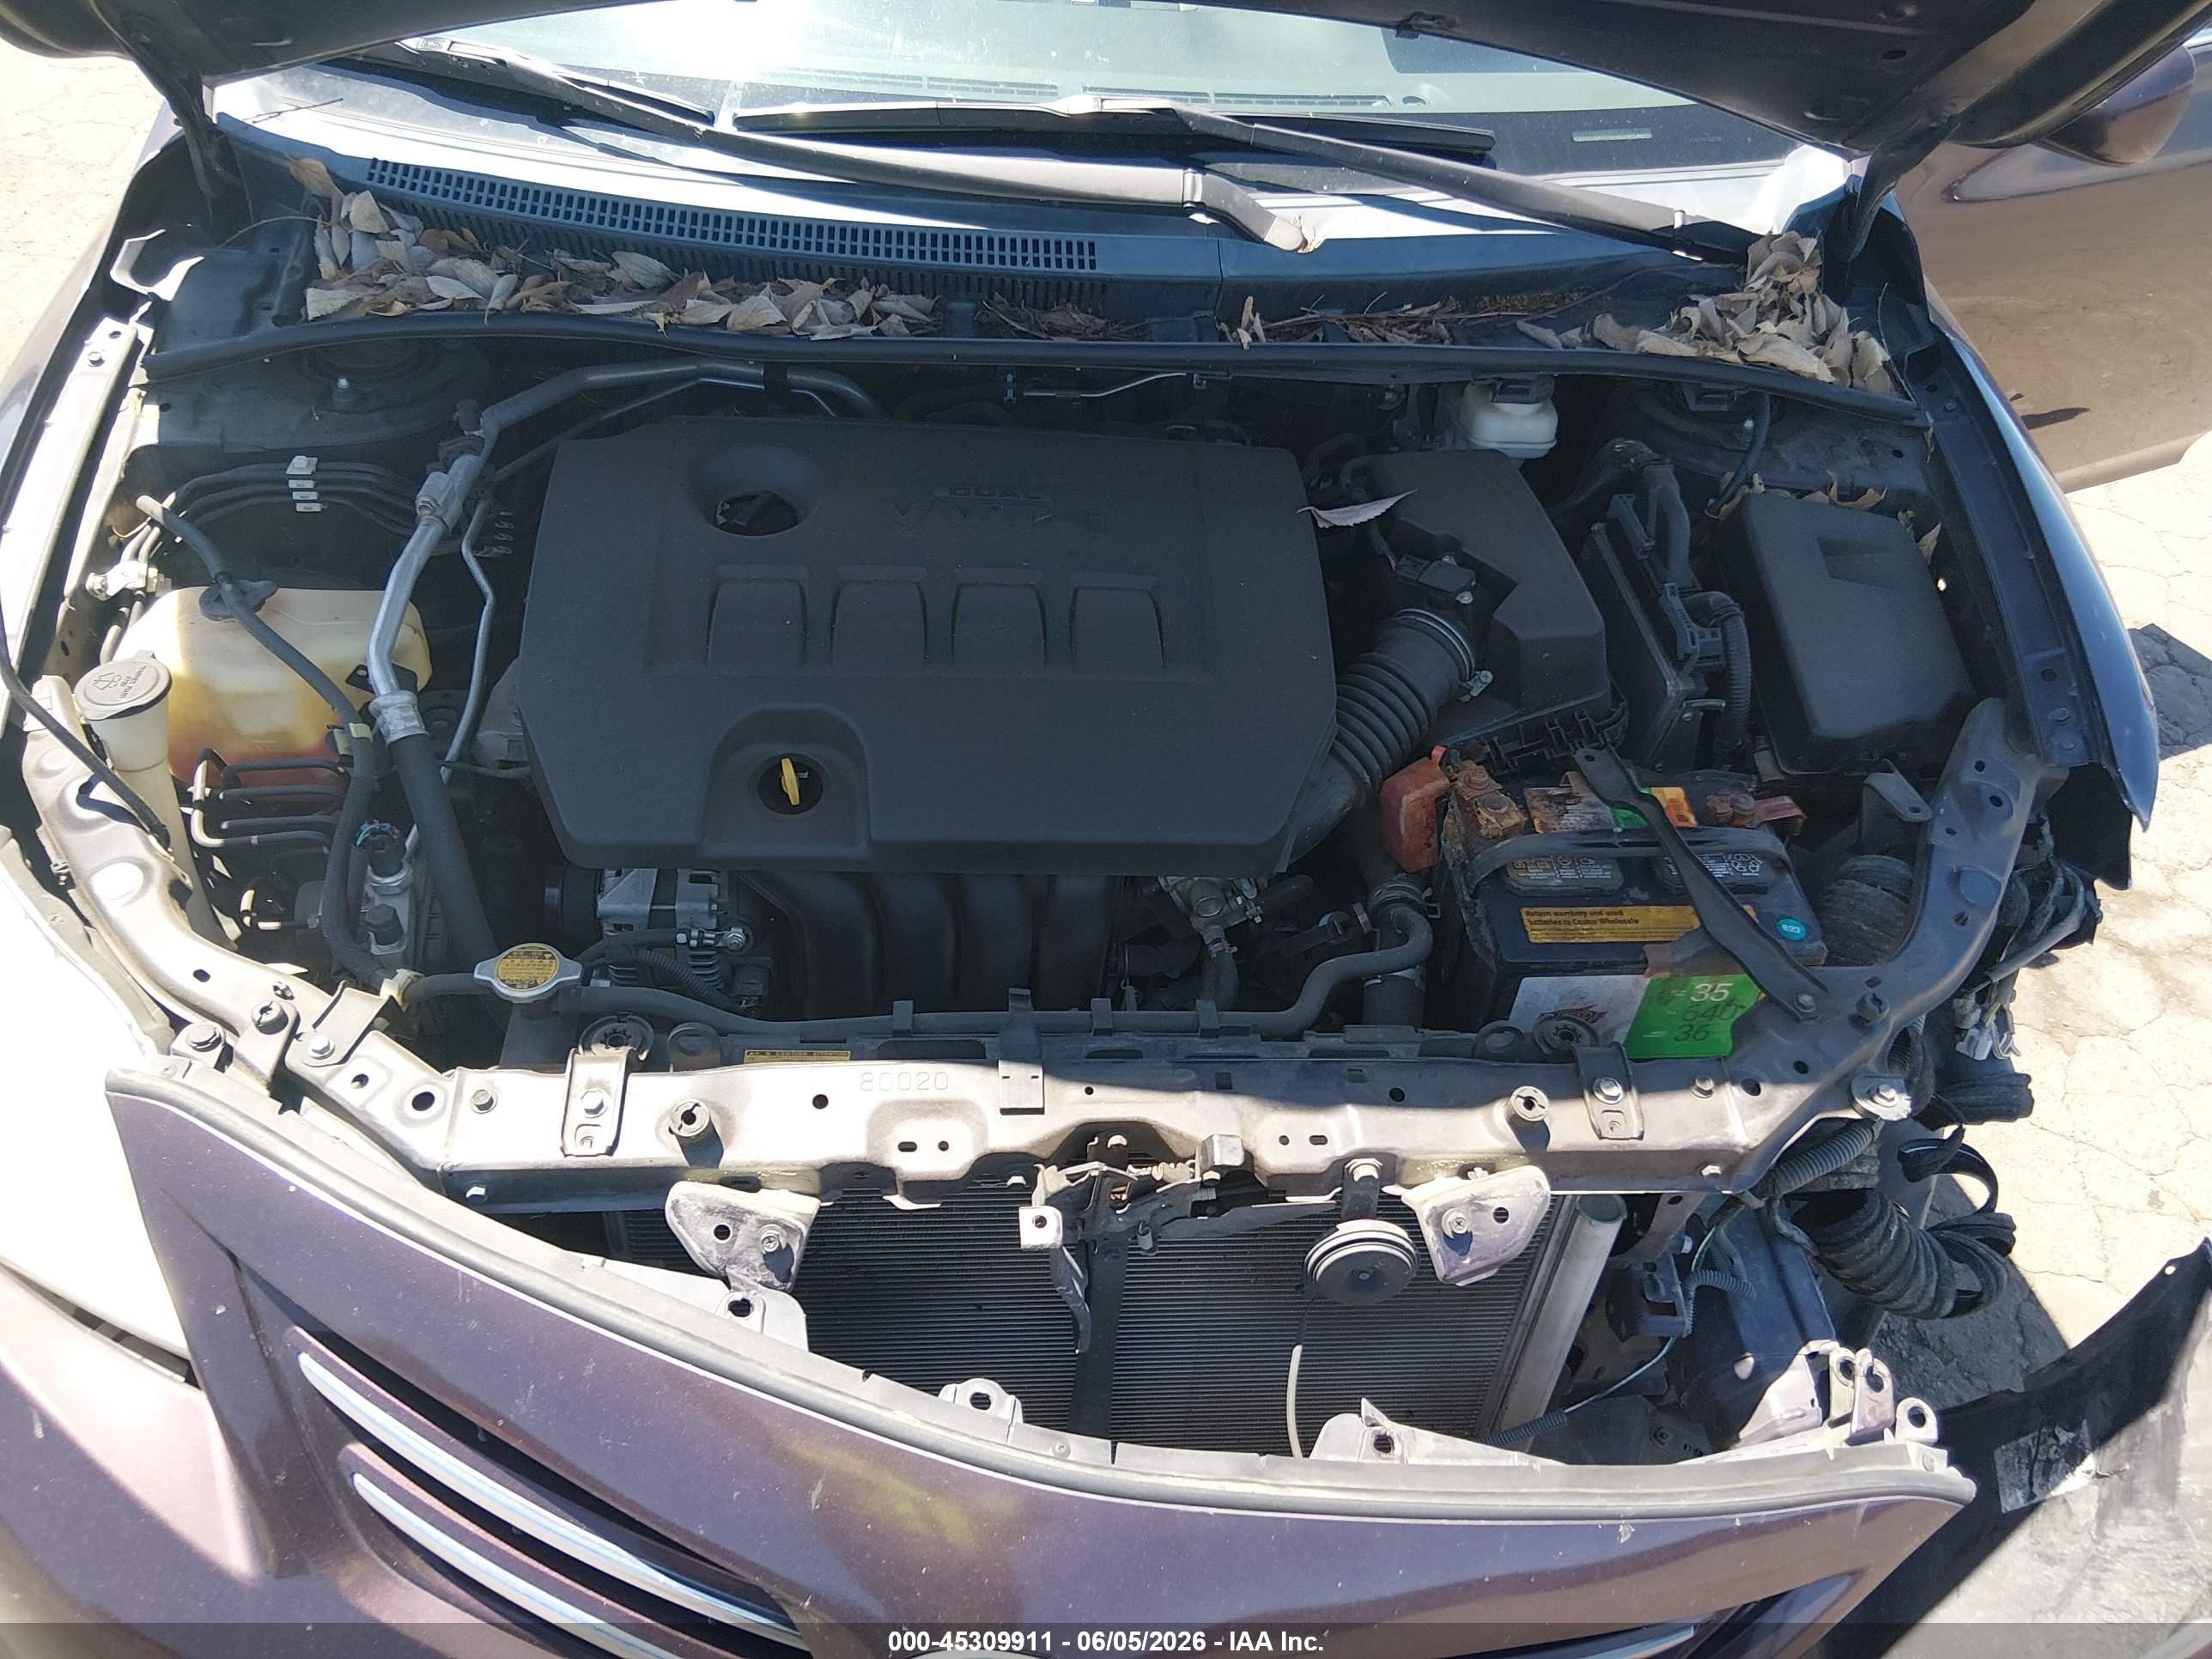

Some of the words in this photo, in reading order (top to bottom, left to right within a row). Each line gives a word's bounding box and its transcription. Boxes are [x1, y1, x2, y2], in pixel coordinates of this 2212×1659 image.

[949, 486, 1042, 500] DUAL
[1689, 982, 1733, 1002] 35
[1674, 1024, 1713, 1042] 36
